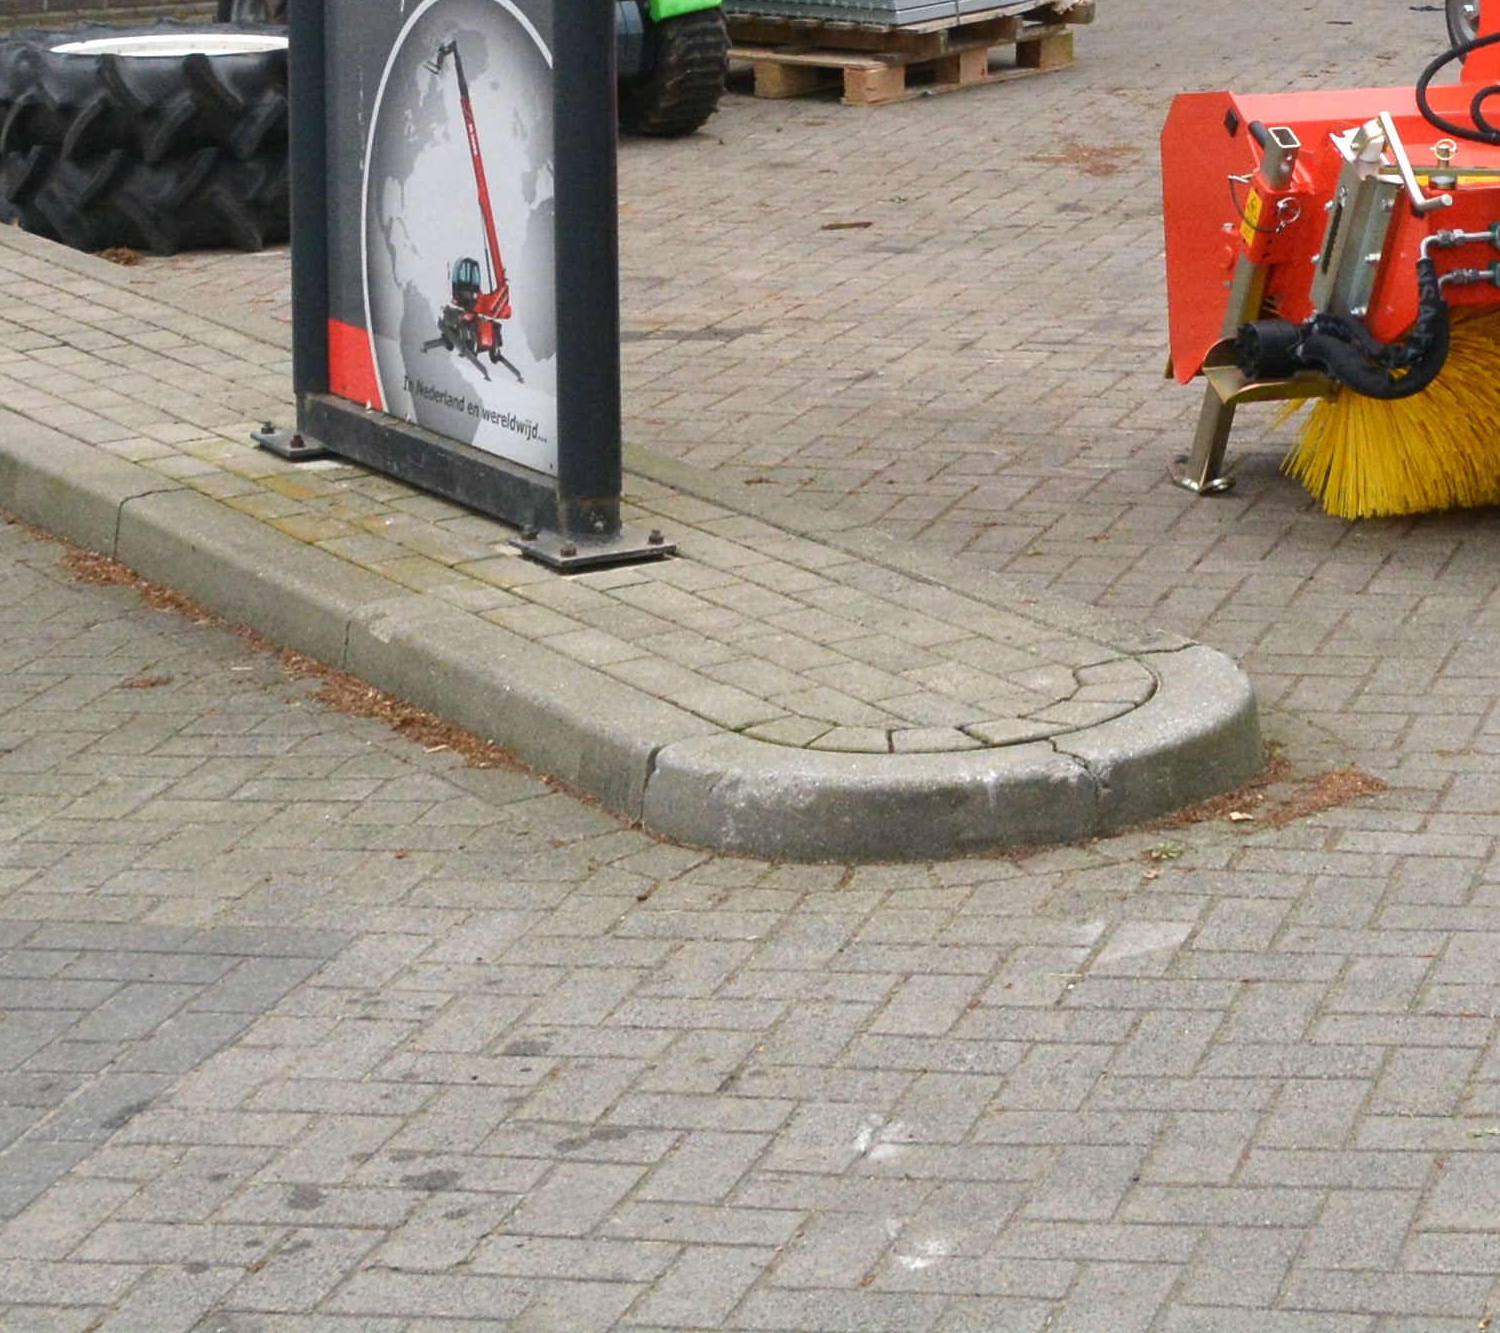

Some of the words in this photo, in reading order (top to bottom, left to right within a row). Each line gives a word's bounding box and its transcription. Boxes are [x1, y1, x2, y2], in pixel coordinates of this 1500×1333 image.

[403, 375, 414, 392] In
[416, 382, 465, 412] Nederland
[467, 402, 479, 417] en
